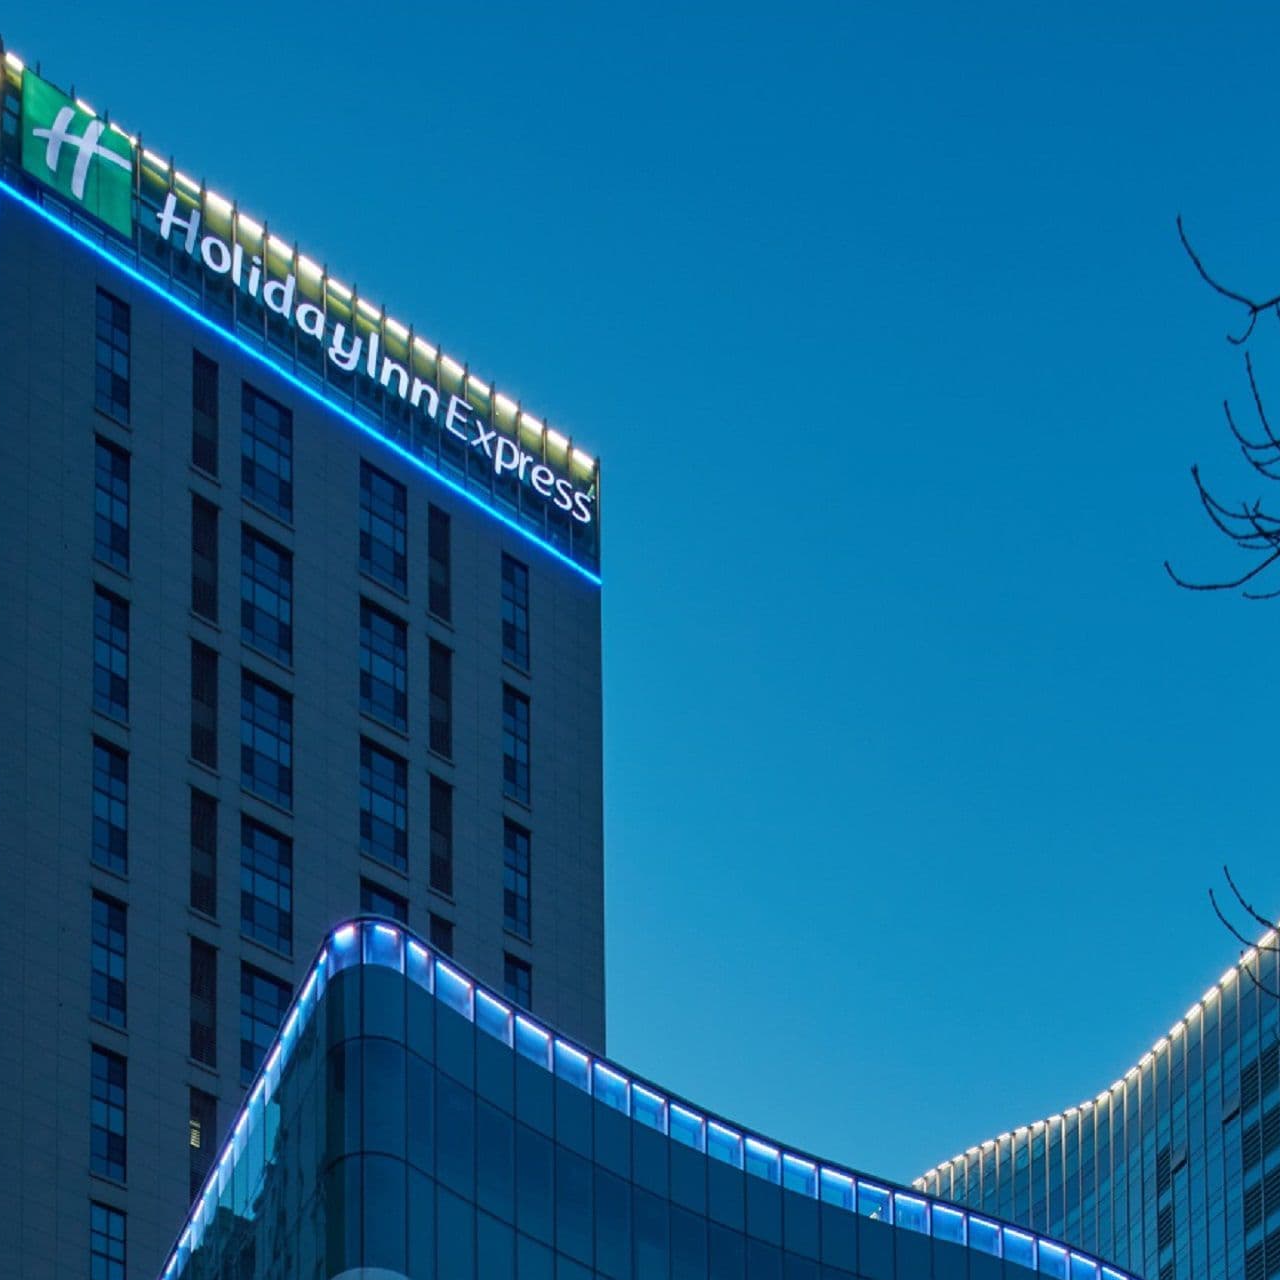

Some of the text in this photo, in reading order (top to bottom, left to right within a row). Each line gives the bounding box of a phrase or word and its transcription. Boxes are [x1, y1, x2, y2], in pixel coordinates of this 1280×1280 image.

[156, 191, 595, 523] Holiday Inn Express
